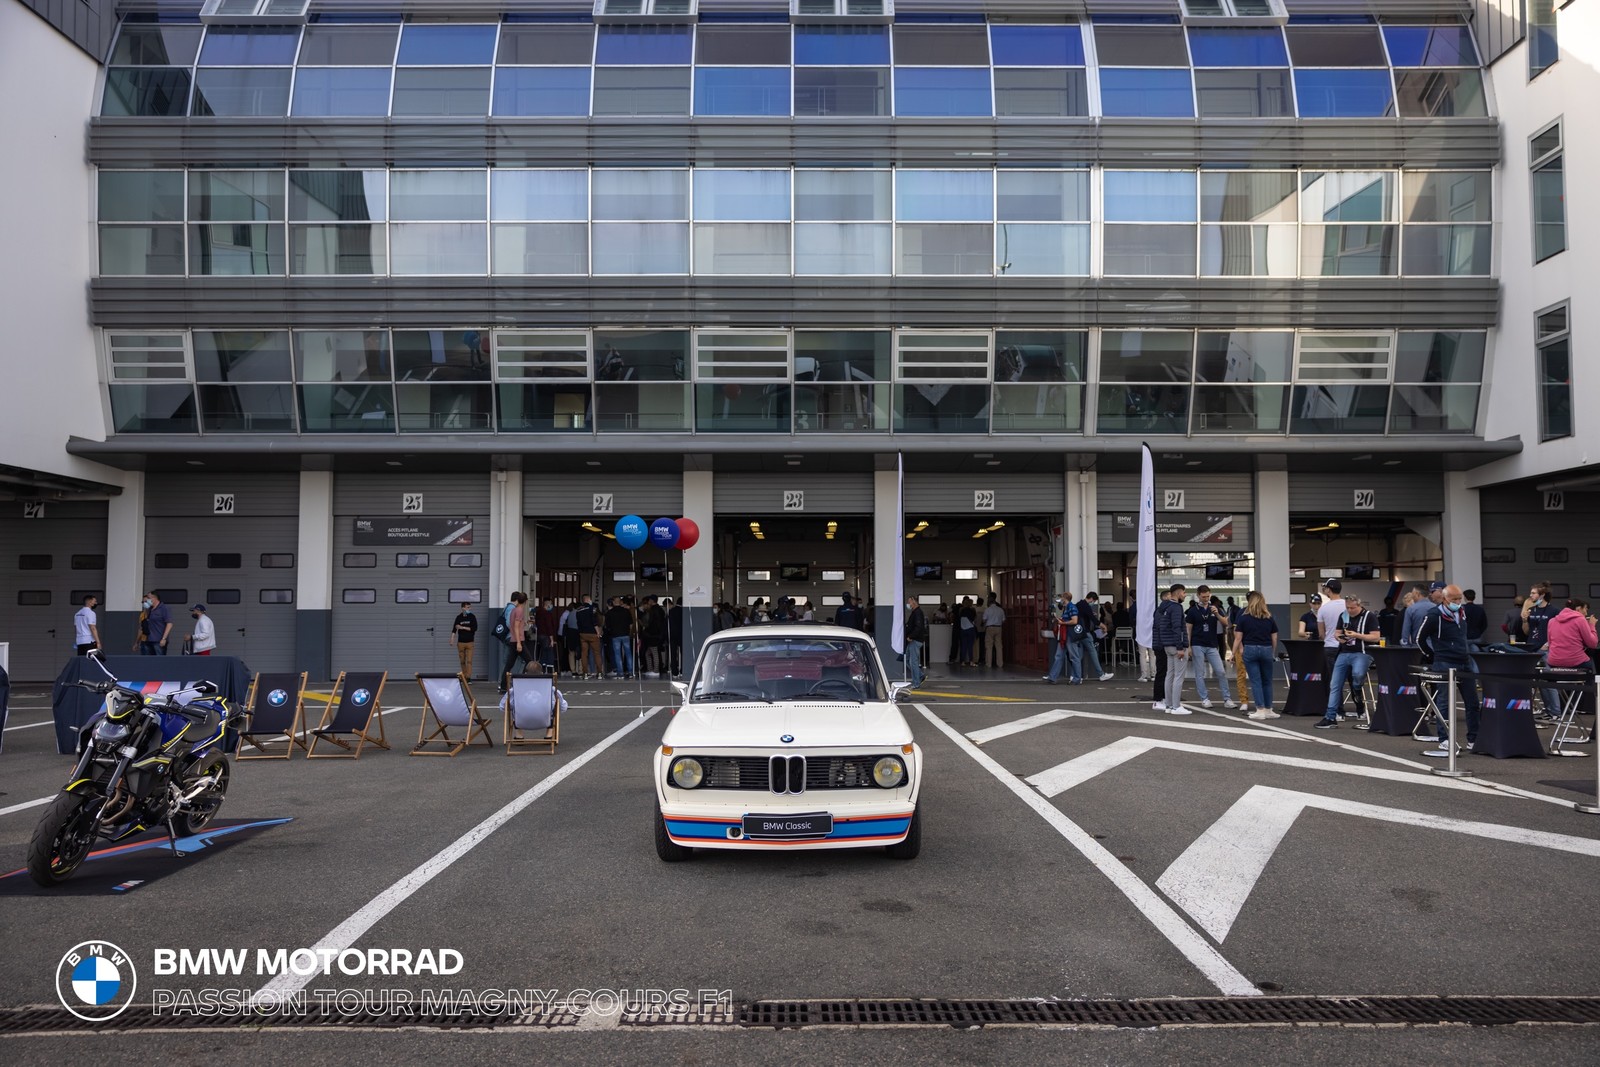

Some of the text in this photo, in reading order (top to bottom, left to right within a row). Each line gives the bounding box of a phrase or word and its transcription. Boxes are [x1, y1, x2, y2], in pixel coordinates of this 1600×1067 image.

[214, 496, 233, 511] 26
[404, 495, 422, 510] 25
[594, 495, 612, 510] 24
[784, 492, 802, 508] 23
[975, 492, 993, 508] 22
[1166, 492, 1182, 507] 21
[1355, 492, 1374, 507] 20
[1546, 492, 1561, 508] 19
[26, 501, 43, 518] 27
[763, 821, 812, 830] BMW Classic
